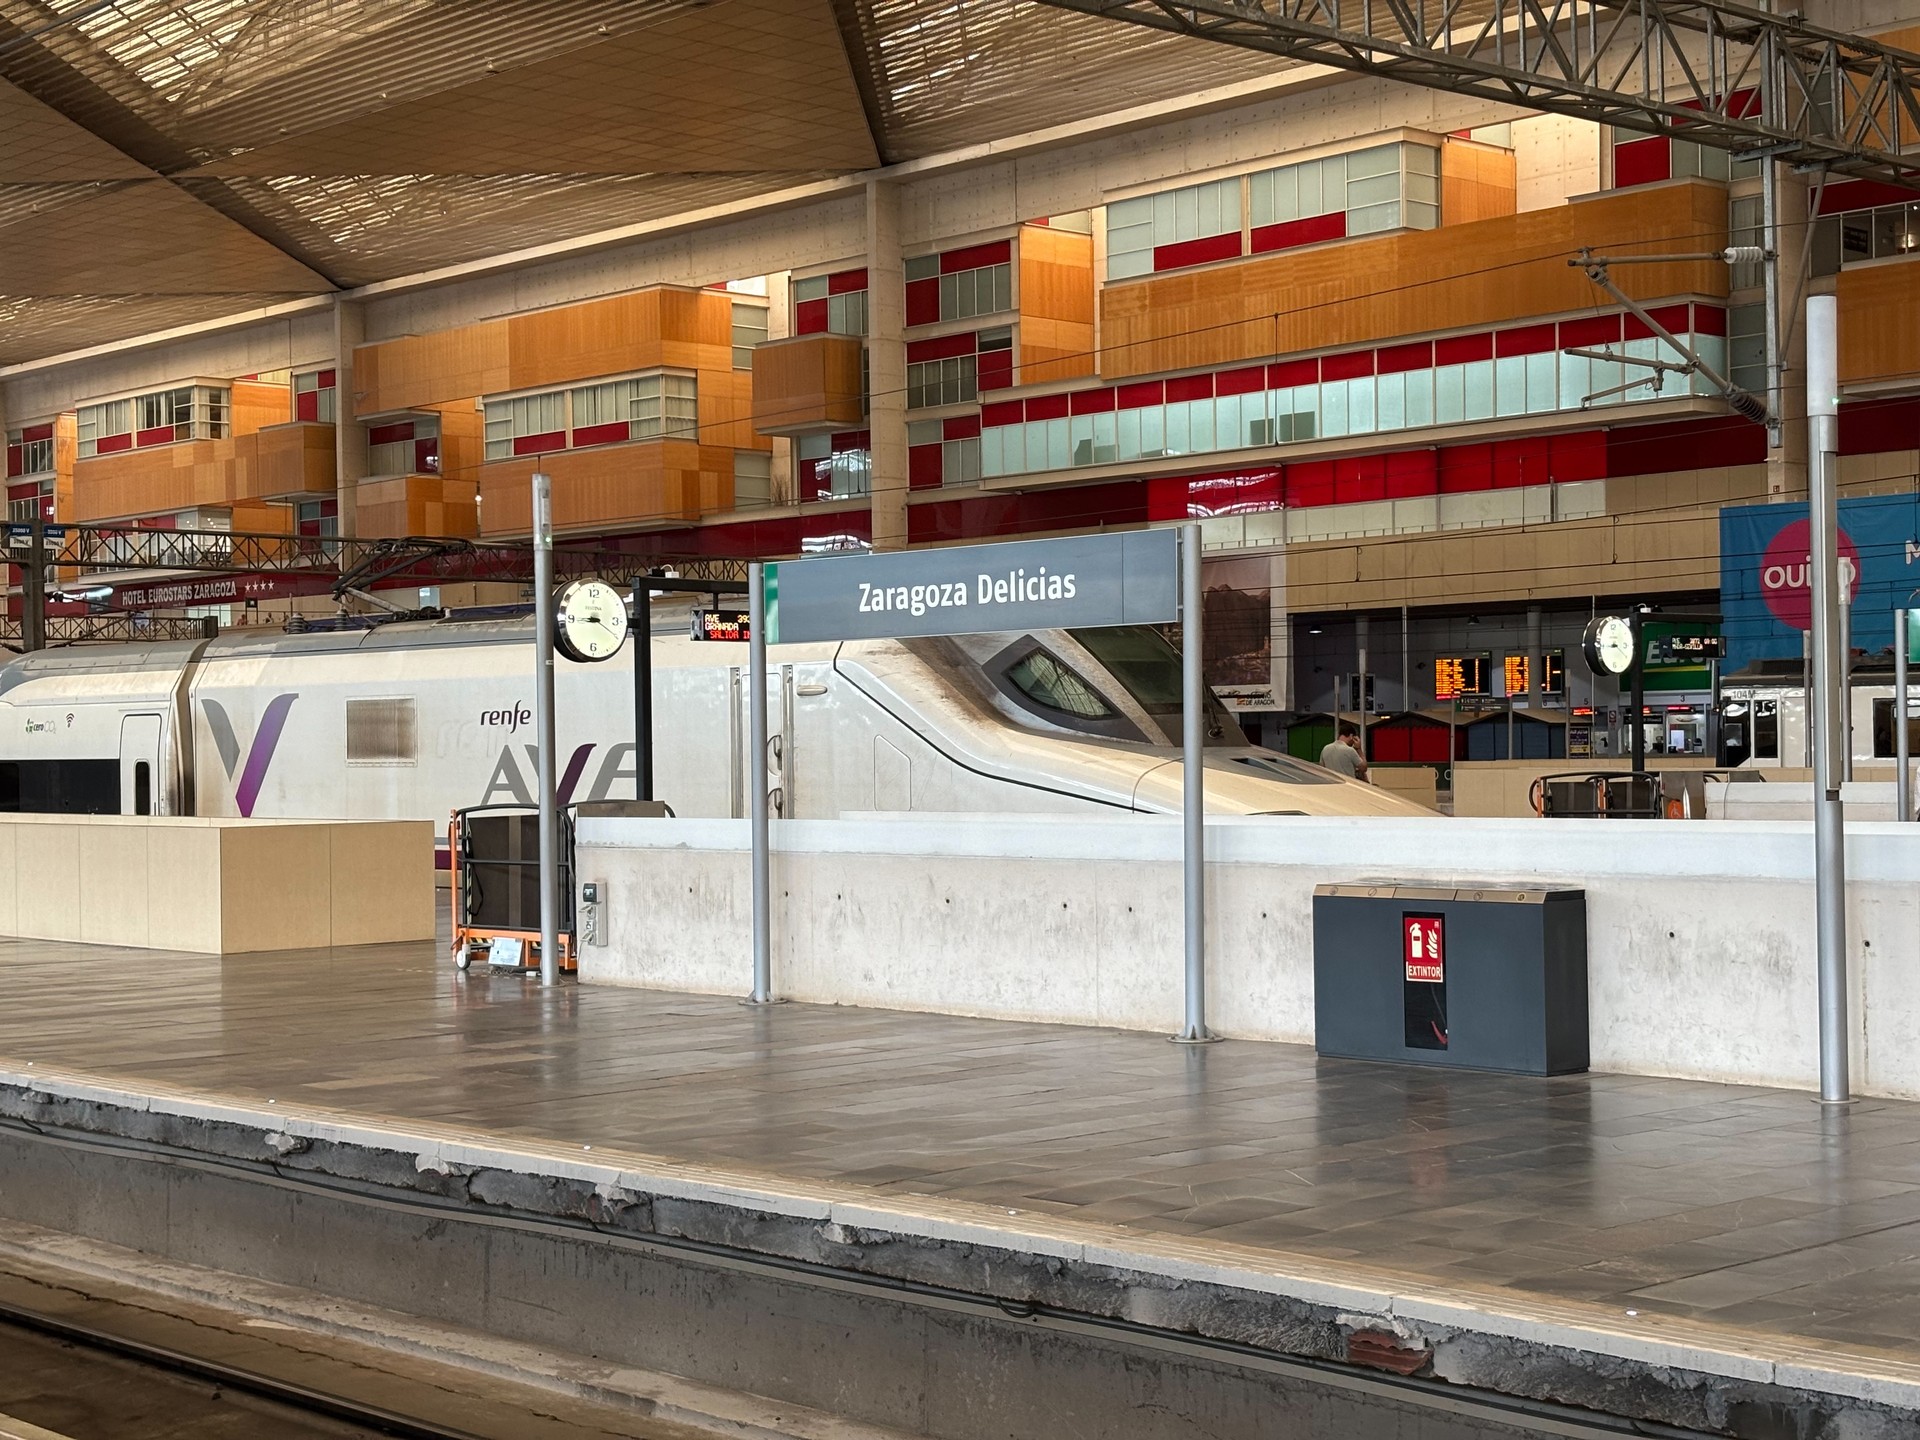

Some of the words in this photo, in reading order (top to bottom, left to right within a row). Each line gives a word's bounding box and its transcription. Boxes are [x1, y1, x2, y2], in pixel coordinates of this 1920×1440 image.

[1764, 555, 1856, 589] oui
[122, 590, 146, 606] HOTEL
[148, 585, 193, 605] EUROSTARS
[194, 581, 237, 599] ZARAGOZA
[588, 589, 600, 599] 12
[858, 582, 967, 617] Zaragoza
[977, 566, 1076, 605] Delicias
[567, 614, 575, 624] 9
[612, 616, 620, 626] 3
[705, 614, 720, 623] AVE
[705, 622, 739, 631] GRANADA
[710, 630, 740, 639] SALIDA
[589, 642, 597, 652] 6
[1732, 690, 1756, 699] 104M
[480, 700, 532, 734] renfe
[480, 743, 637, 807] AVE
[1408, 965, 1441, 978] EXTINTOR
